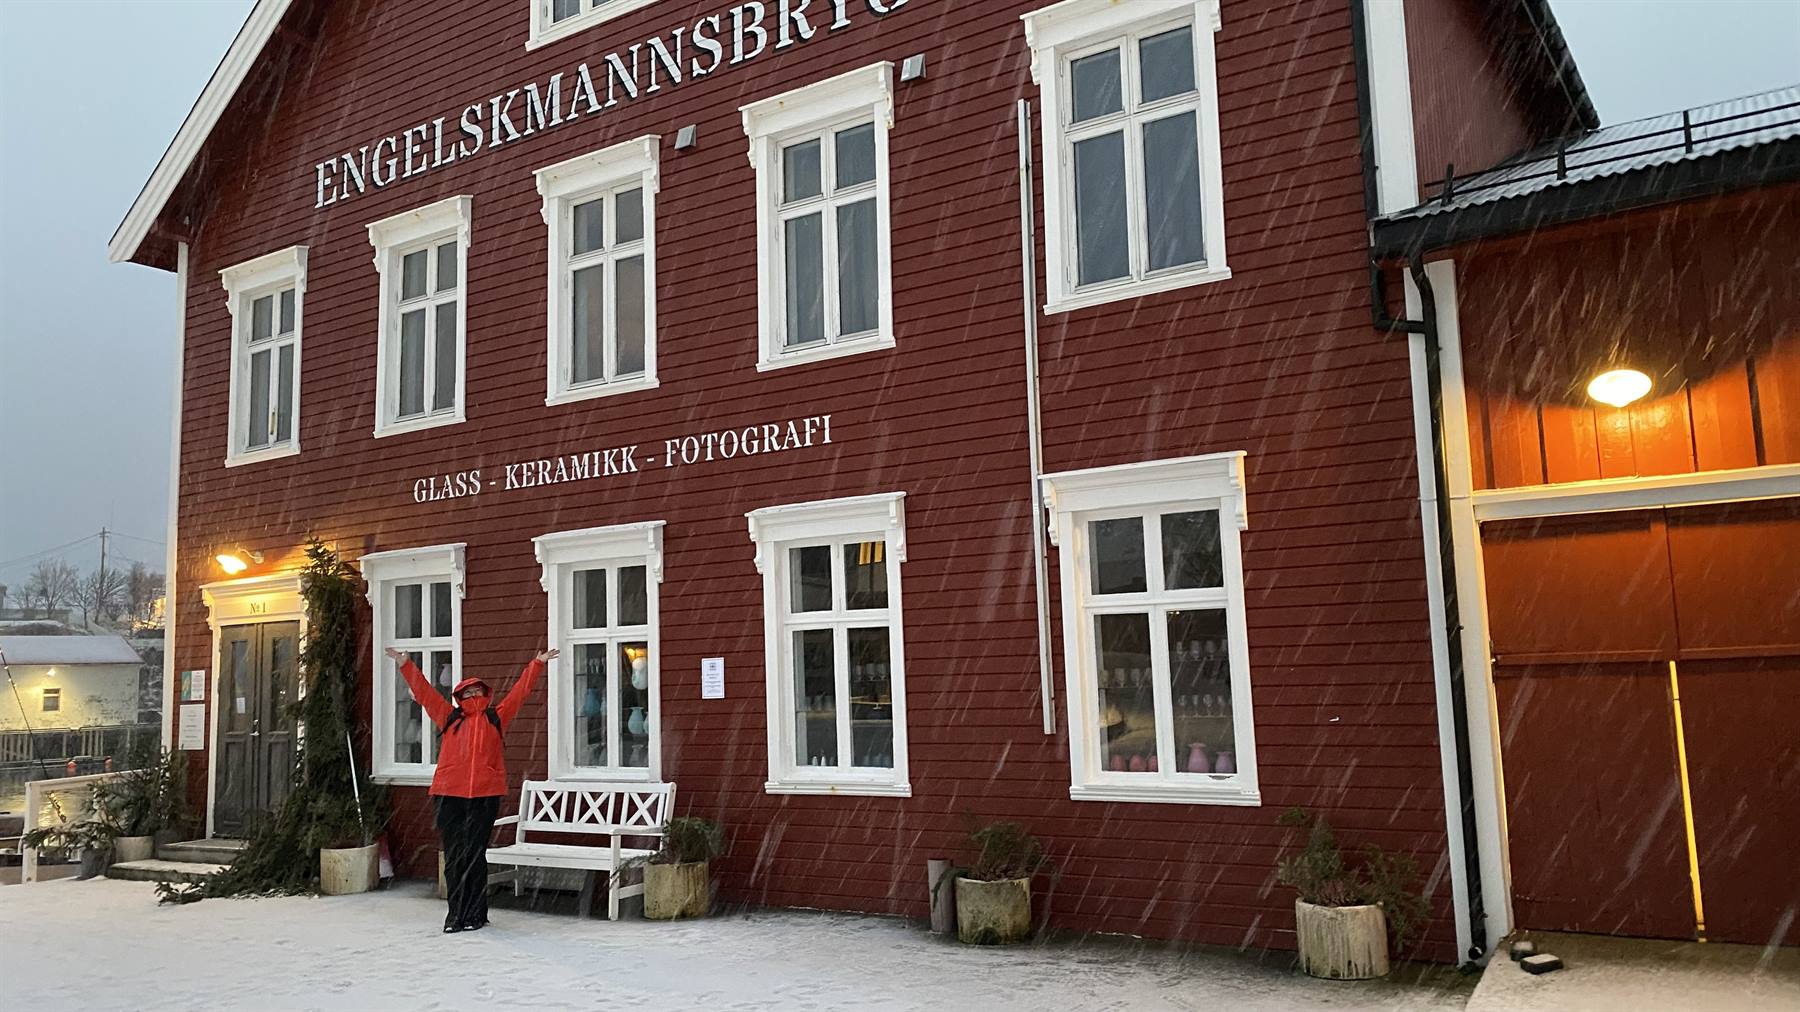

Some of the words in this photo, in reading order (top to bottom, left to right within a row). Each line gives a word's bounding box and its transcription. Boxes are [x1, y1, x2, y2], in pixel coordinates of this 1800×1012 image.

[314, 0, 909, 209] ENGELSKMANNSBR
[413, 469, 482, 503] GLASS
[504, 445, 638, 490] KERAMIKK
[664, 414, 832, 468] FOTOGRAFI
